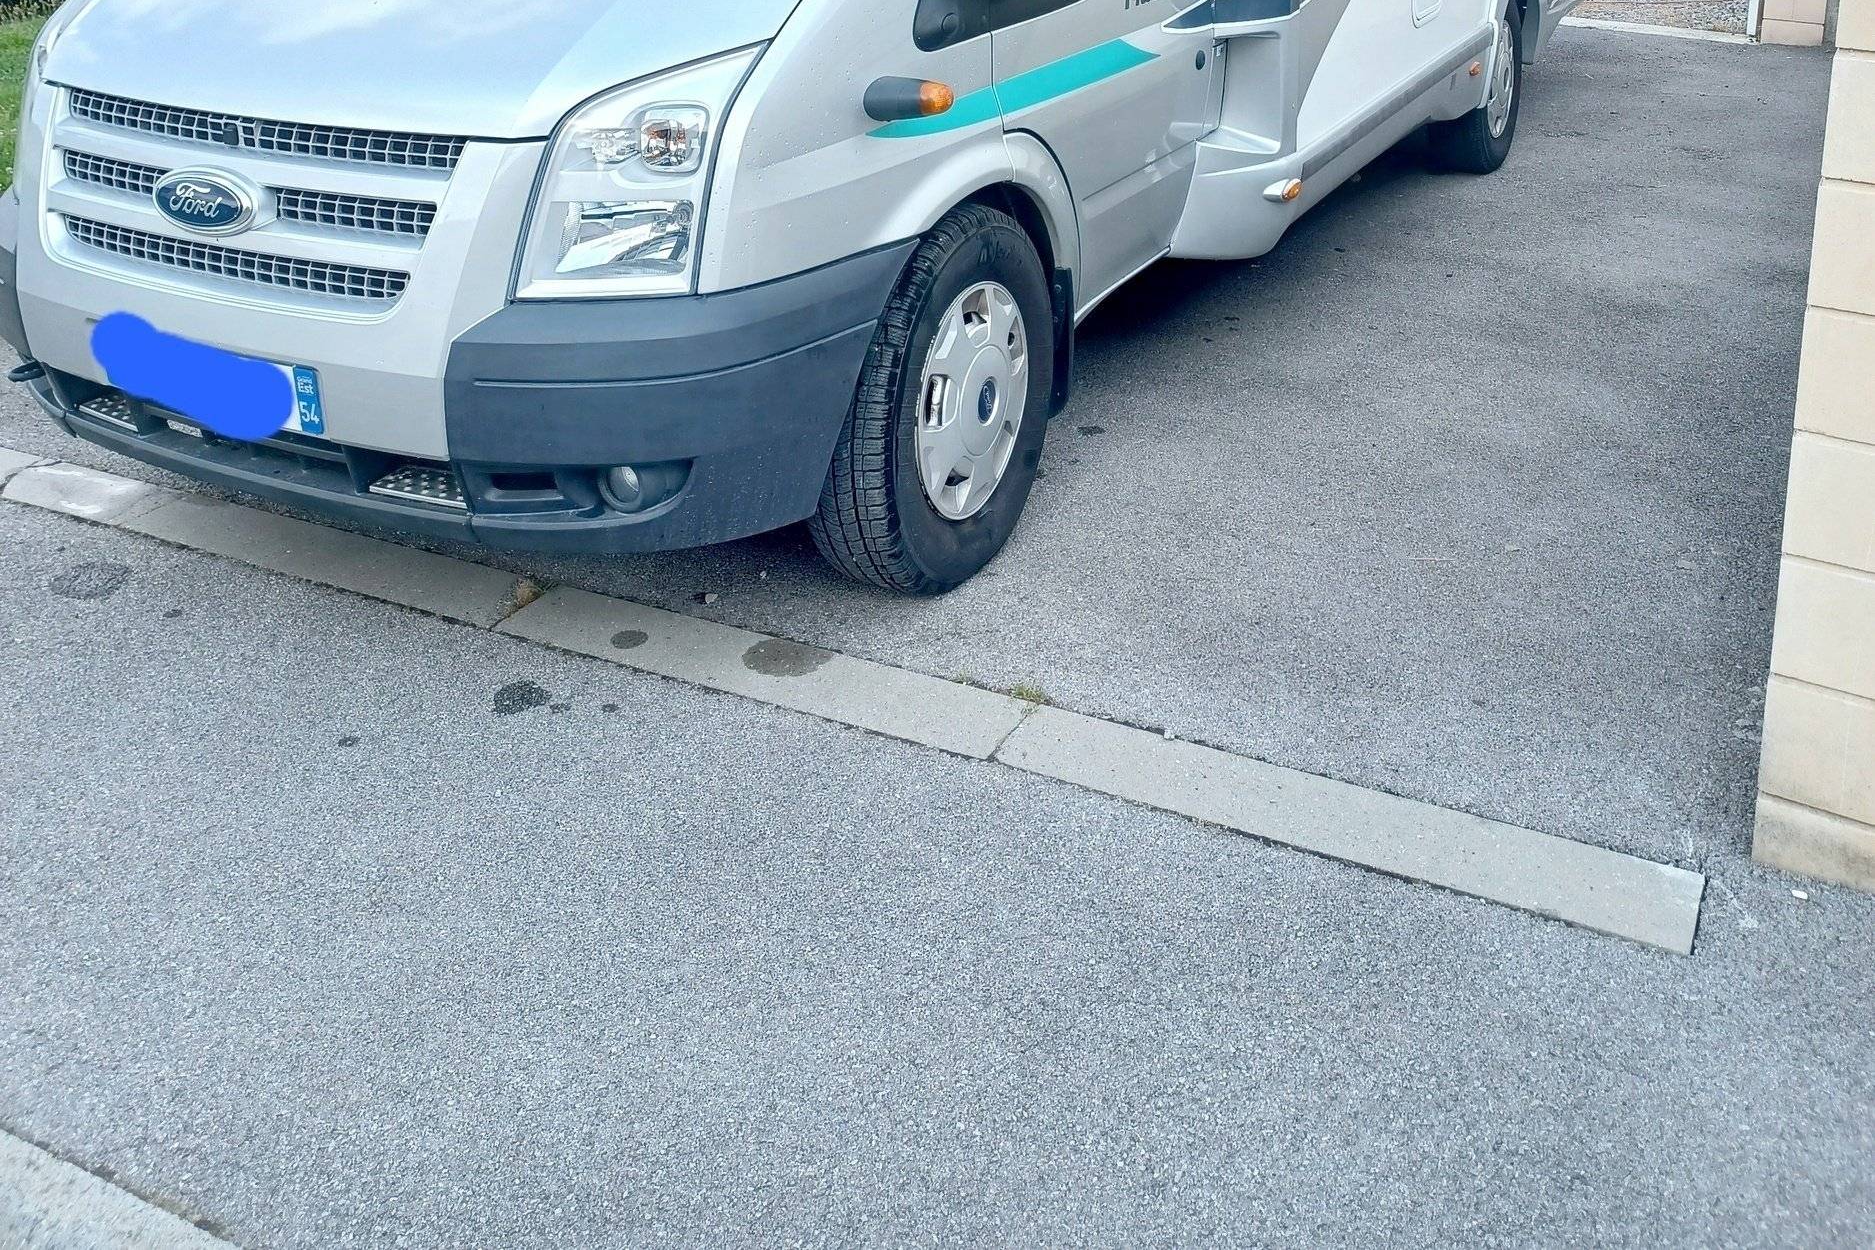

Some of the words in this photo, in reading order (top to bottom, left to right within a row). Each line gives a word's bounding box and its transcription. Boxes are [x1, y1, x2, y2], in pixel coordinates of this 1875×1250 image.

[169, 182, 223, 219] Ford
[297, 382, 315, 395] Est
[299, 401, 320, 424] 54
